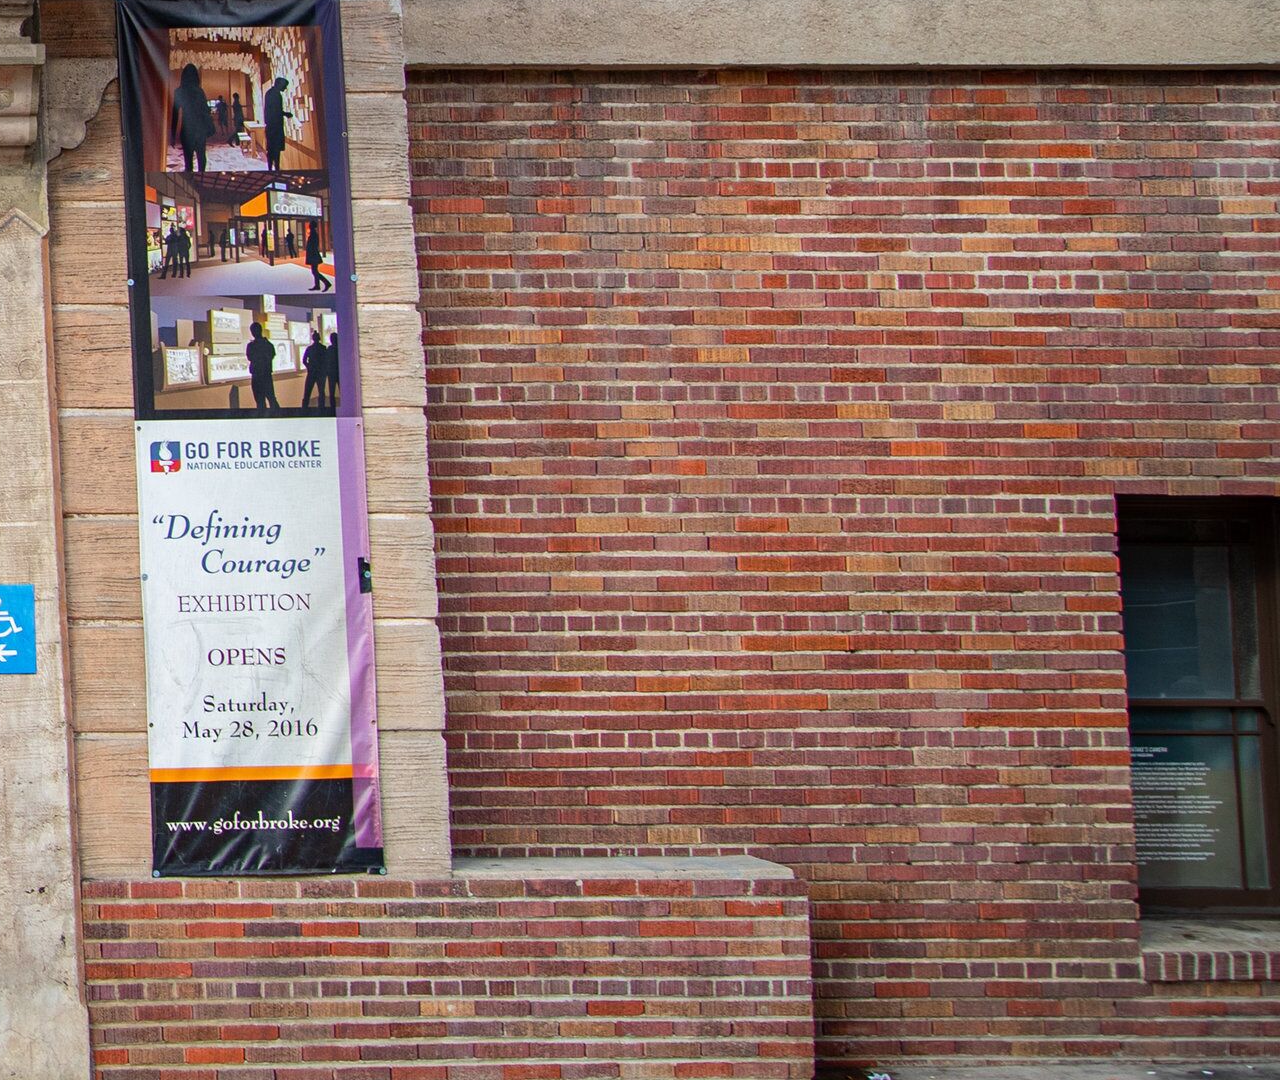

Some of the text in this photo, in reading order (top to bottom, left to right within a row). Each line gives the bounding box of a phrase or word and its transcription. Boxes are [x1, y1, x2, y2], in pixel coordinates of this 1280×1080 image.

[185, 440, 322, 459] GO FOR BROKE
[187, 460, 322, 470] NATIONAL EDUCATION CENTER
[177, 593, 311, 613] EXHIBITION
[207, 647, 286, 666] OPENS
[203, 691, 294, 715] Saturday,
[182, 717, 318, 742] May 28, 2016
[166, 810, 341, 835] www.goforbroke.org
